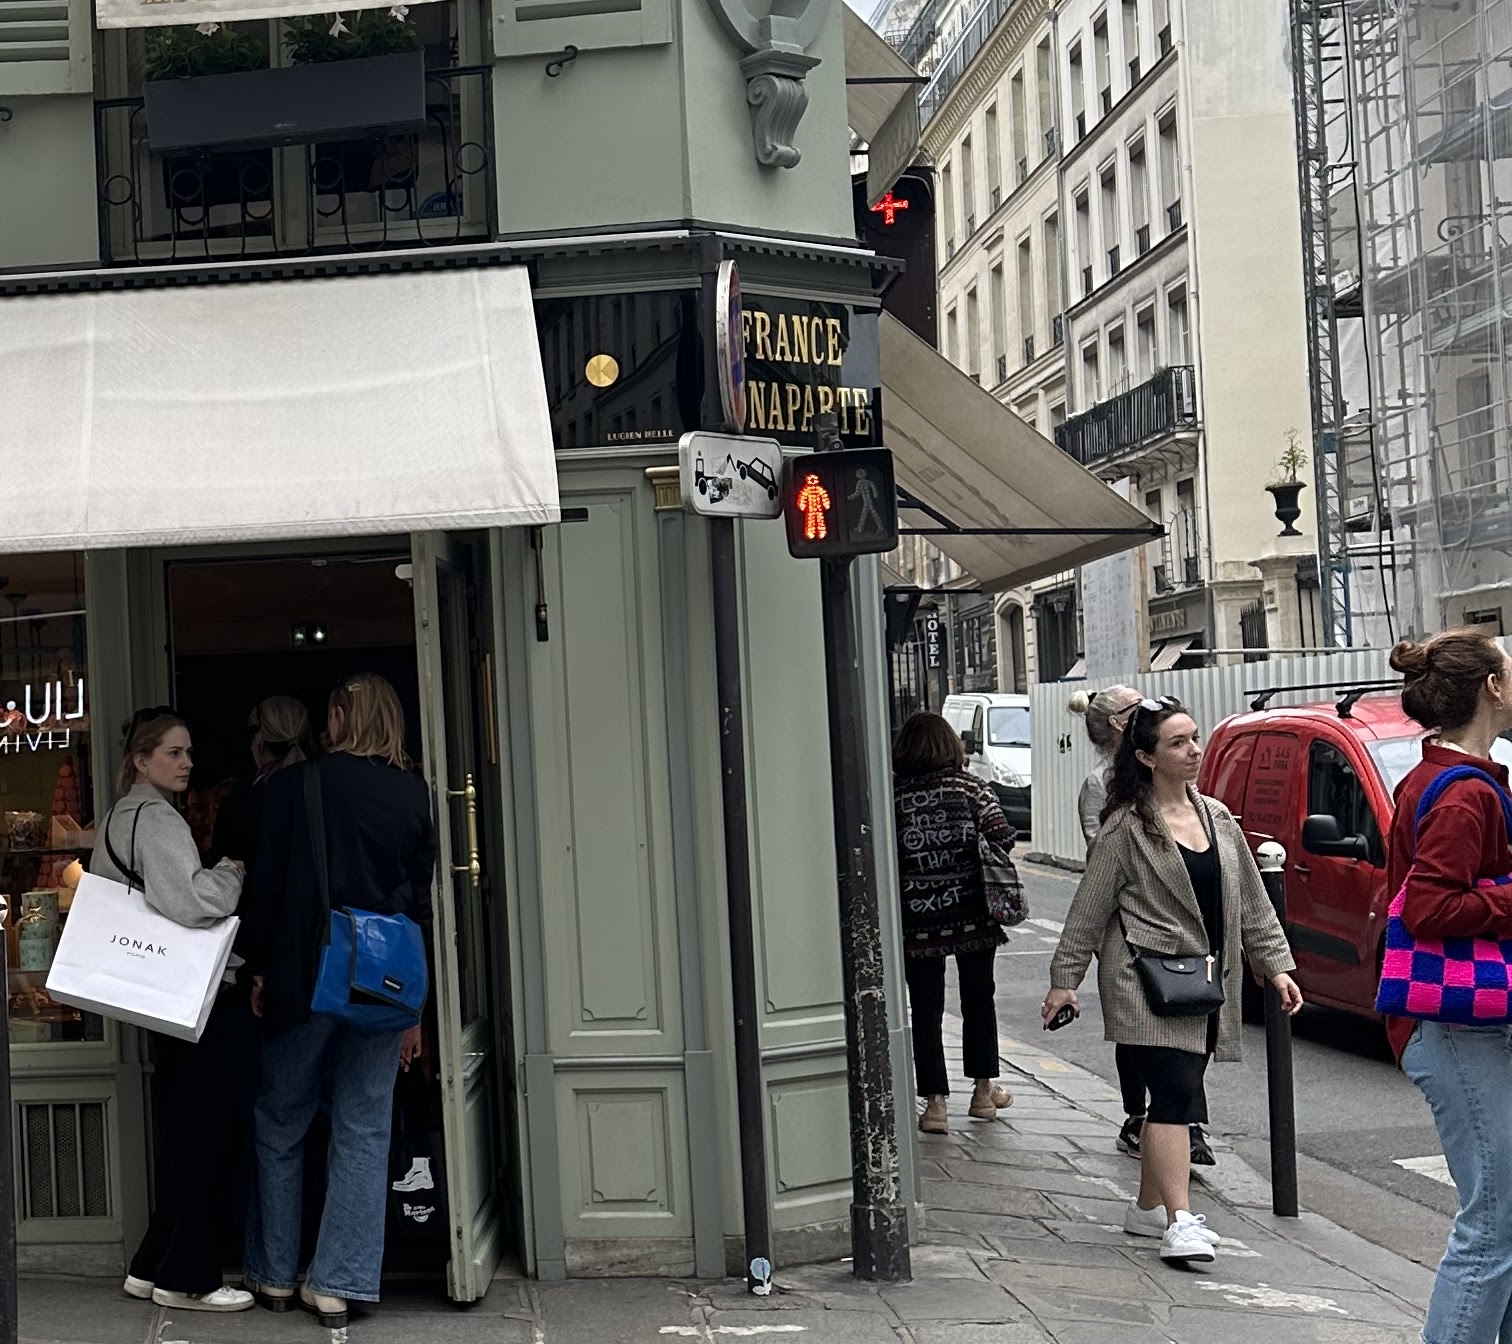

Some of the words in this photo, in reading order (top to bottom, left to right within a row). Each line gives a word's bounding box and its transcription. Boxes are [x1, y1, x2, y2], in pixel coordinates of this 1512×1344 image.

[741, 309, 842, 366] FRANCE
[748, 380, 870, 435] NAPARTE
[110, 934, 167, 956] JONAK
